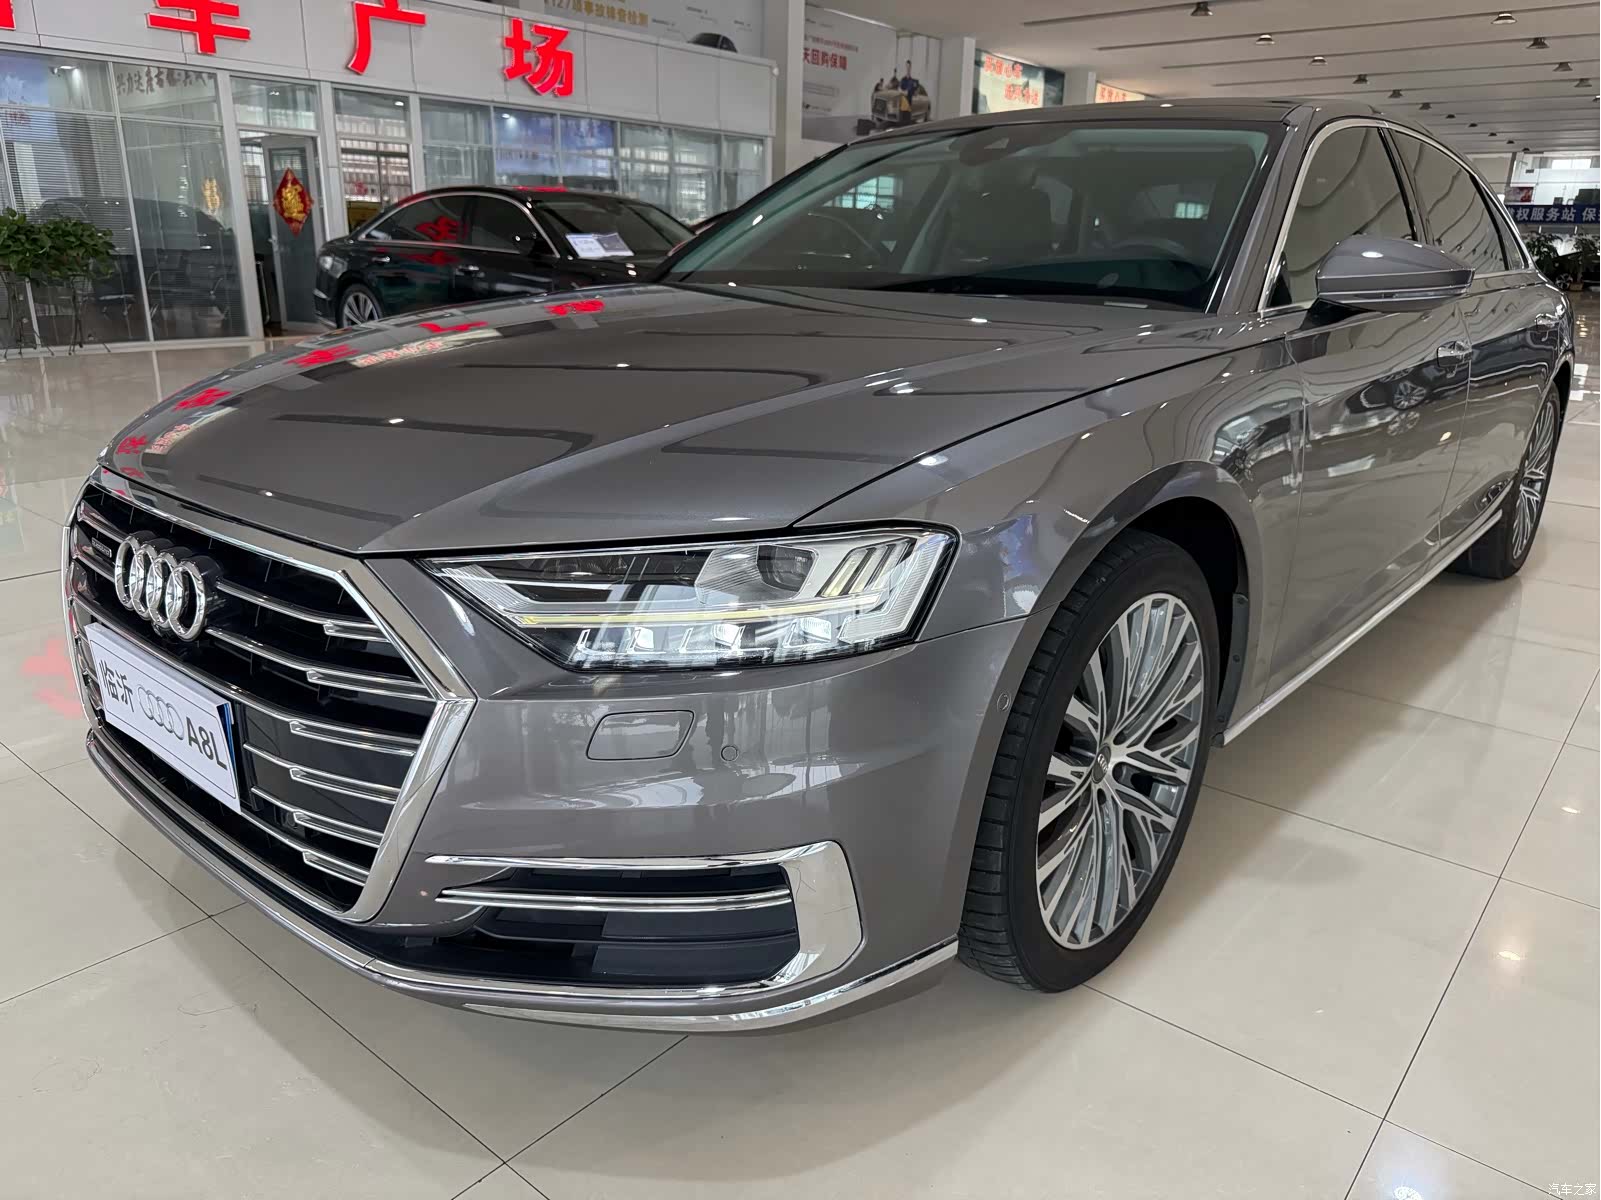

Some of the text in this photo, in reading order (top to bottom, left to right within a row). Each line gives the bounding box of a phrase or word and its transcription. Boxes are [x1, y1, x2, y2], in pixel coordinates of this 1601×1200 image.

[0, 0, 575, 97] 车广场
[1582, 207, 1600, 222] 保
[98, 660, 227, 769] 临沂 A8L
